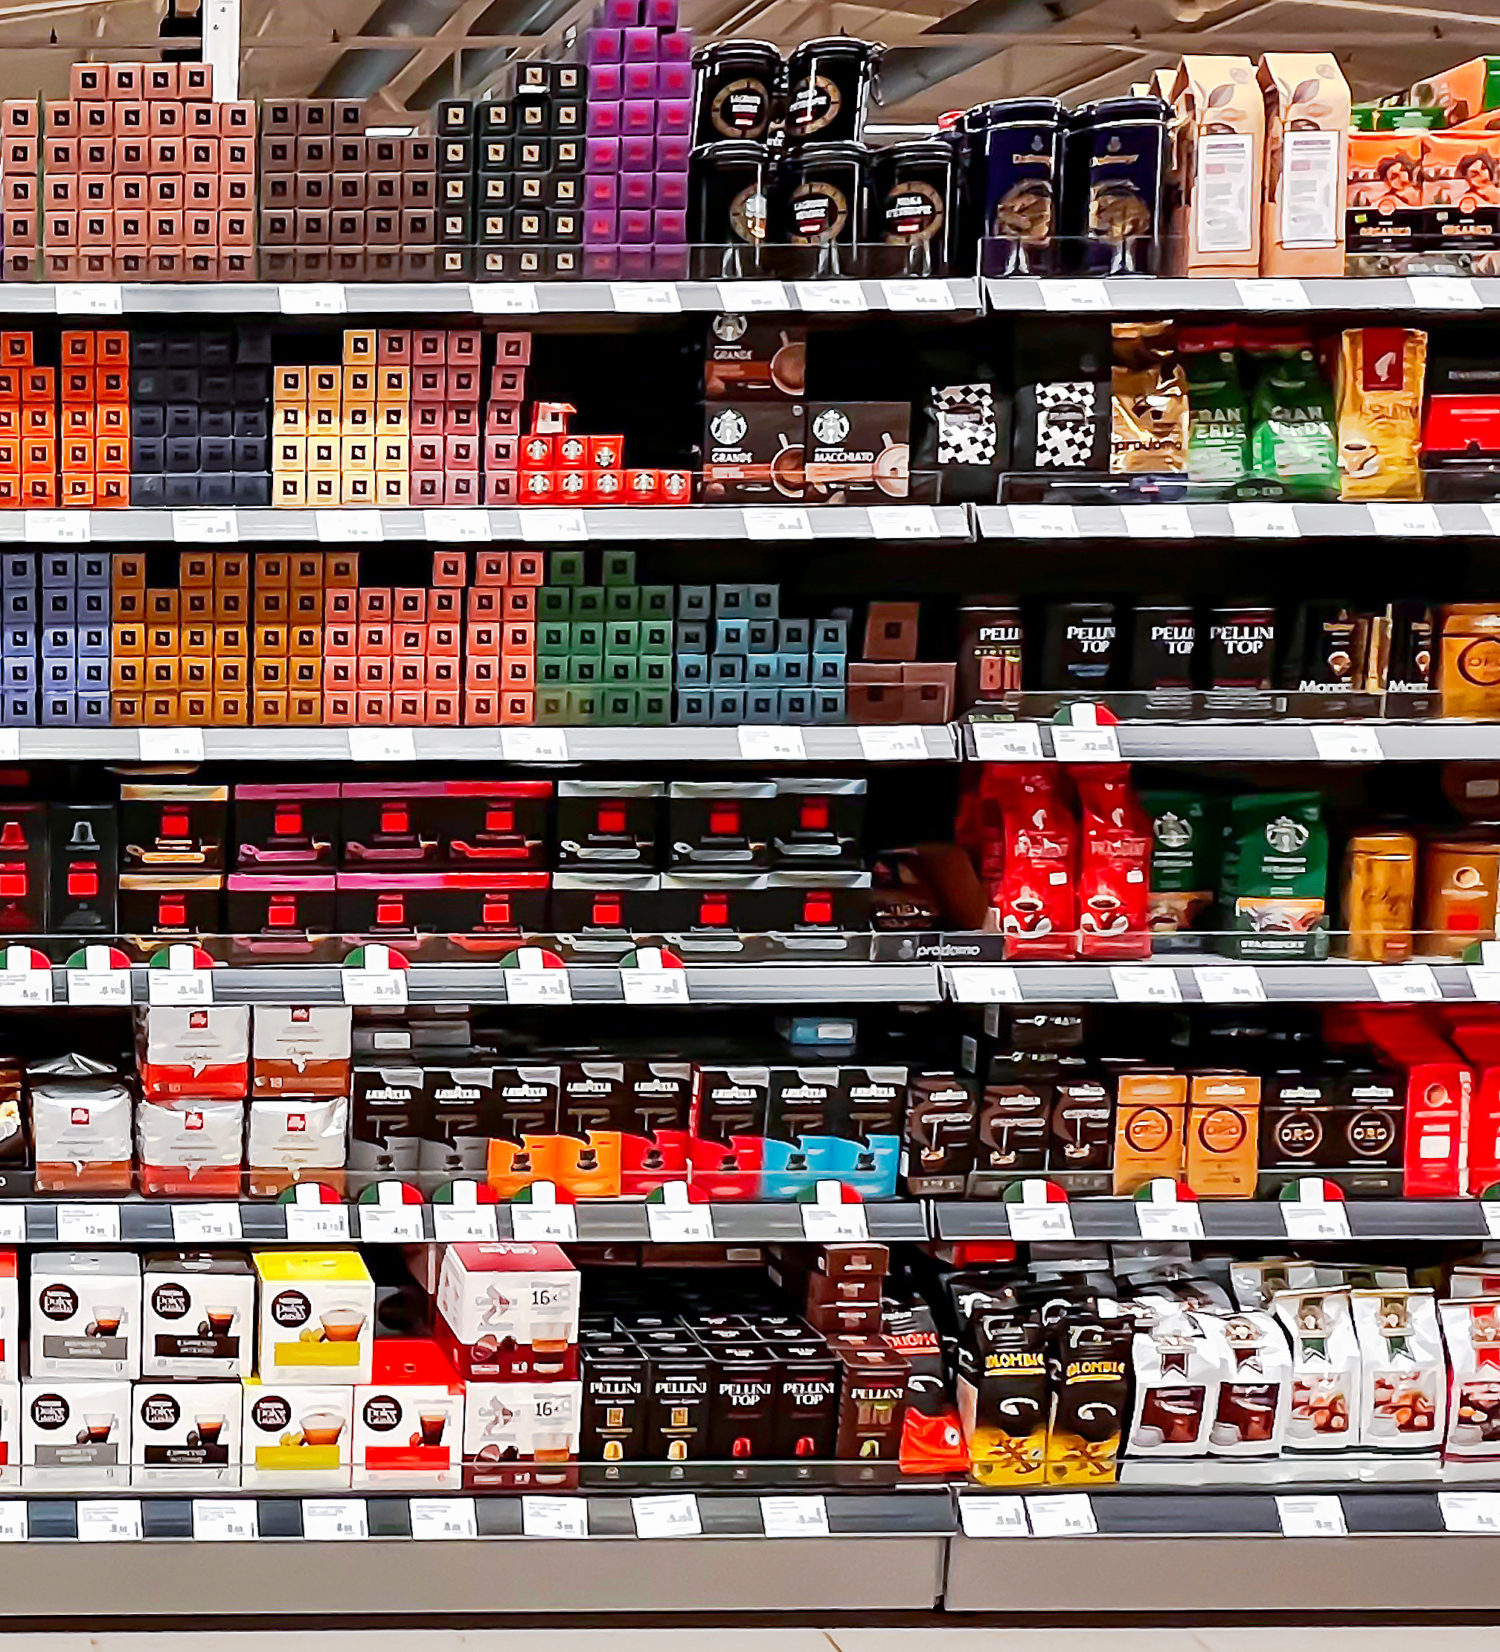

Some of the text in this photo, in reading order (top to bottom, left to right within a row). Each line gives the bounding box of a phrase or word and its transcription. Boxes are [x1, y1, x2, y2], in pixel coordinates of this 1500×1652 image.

[1209, 626, 1275, 640] PELLINI
[1080, 640, 1110, 654] TOP
[1224, 640, 1265, 655] TOP
[589, 1381, 642, 1394] PELLINI
[654, 1382, 707, 1394] PELLINI
[731, 1394, 761, 1406] TOP
[796, 1394, 824, 1405] TOP
